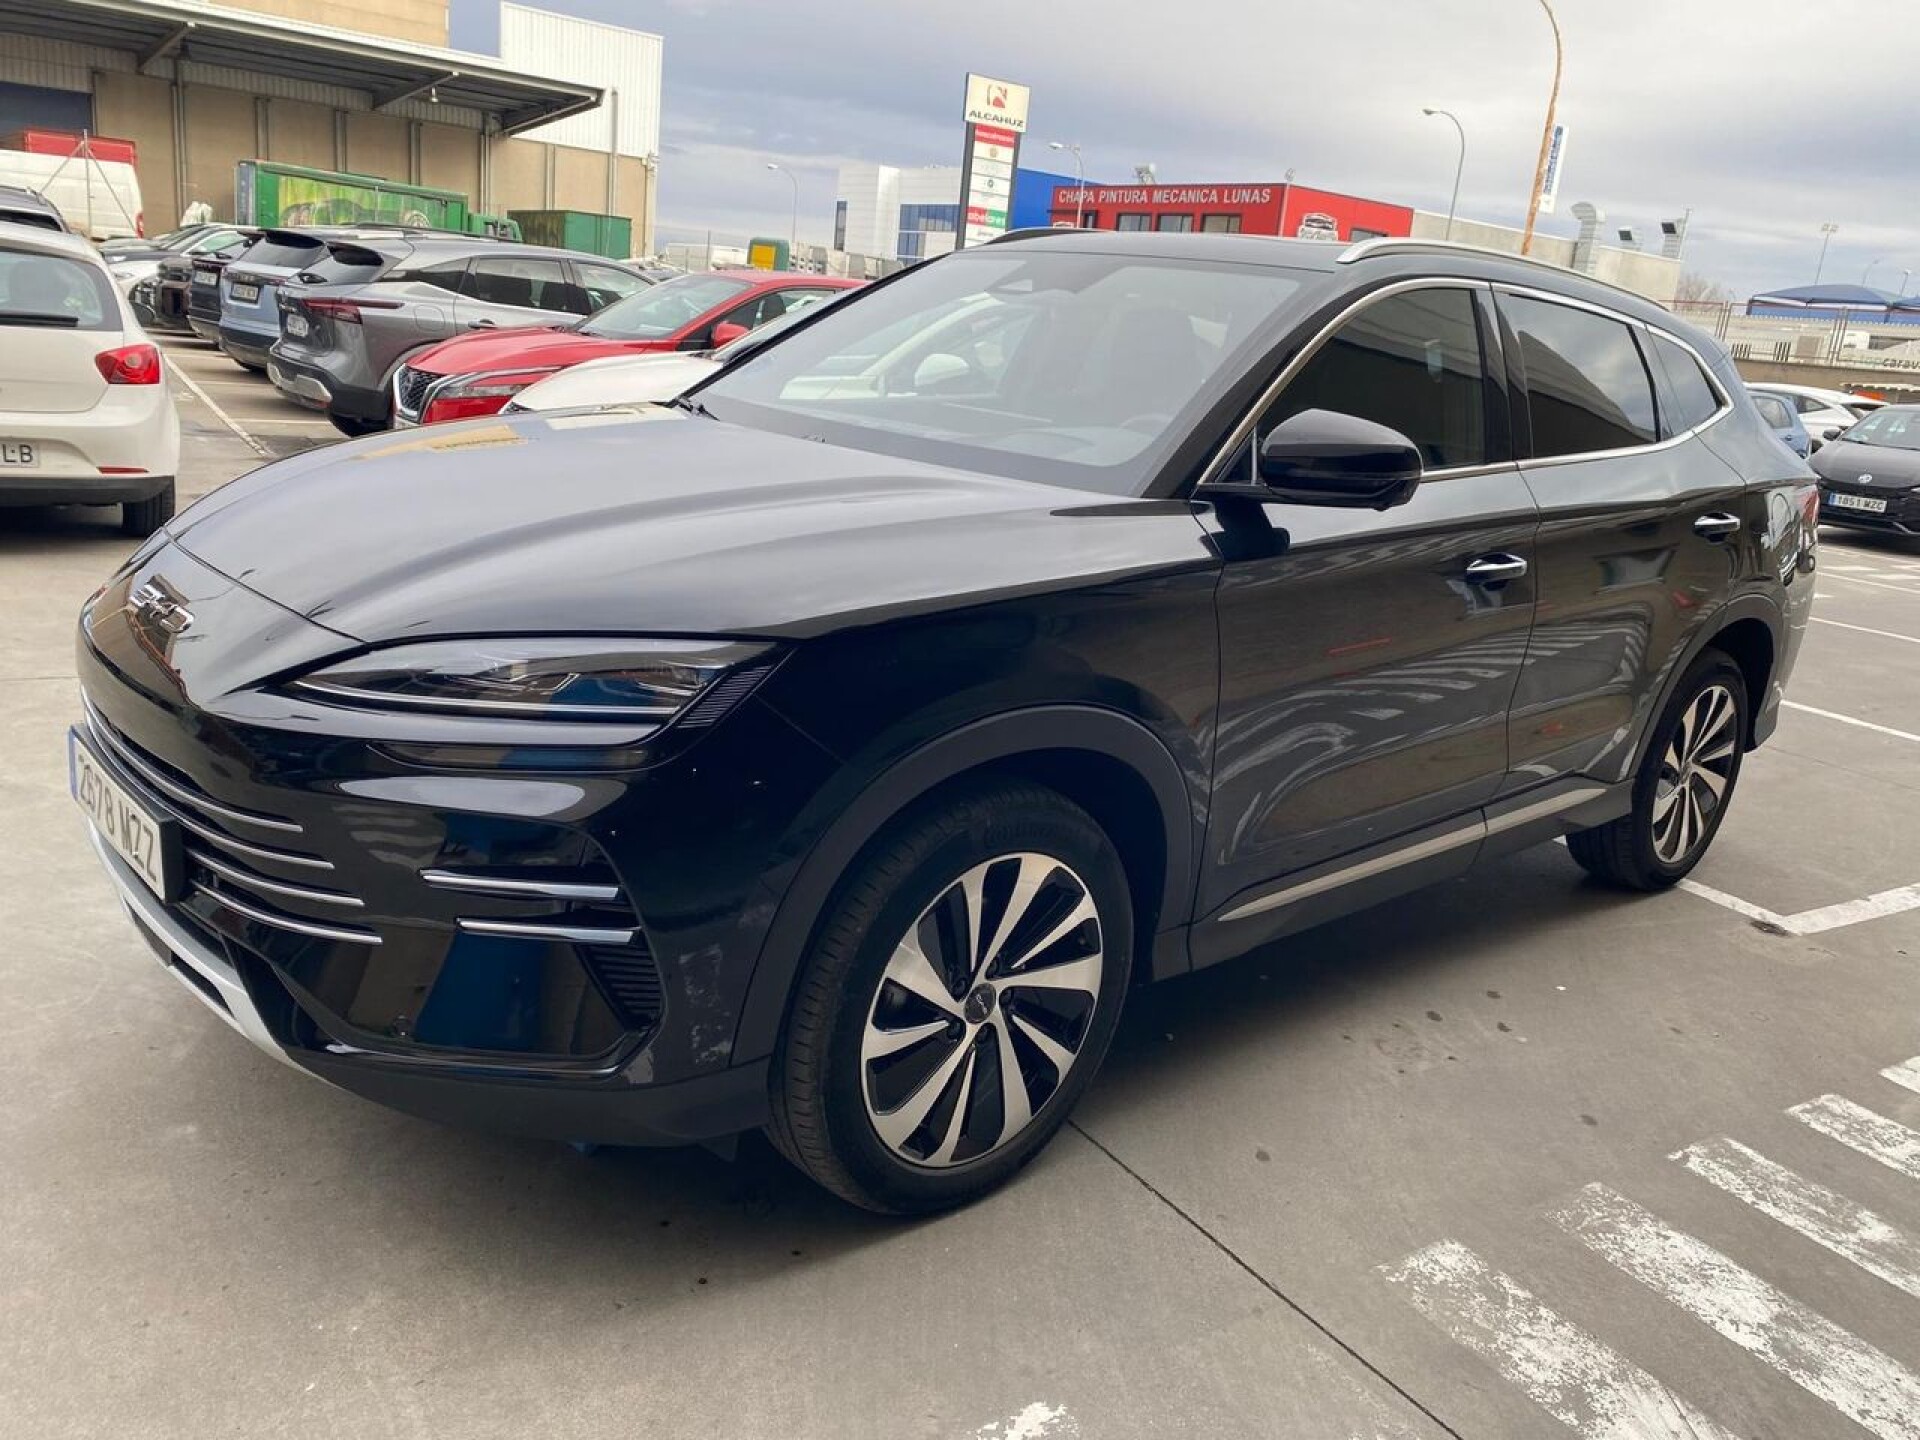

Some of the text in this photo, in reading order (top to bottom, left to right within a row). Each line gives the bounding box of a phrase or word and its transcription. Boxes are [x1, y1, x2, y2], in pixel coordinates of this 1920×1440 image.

[1058, 188, 1271, 204] CHAPA PINTURA MECANICA LUNAS
[78, 754, 157, 882] 2678 MZZ
